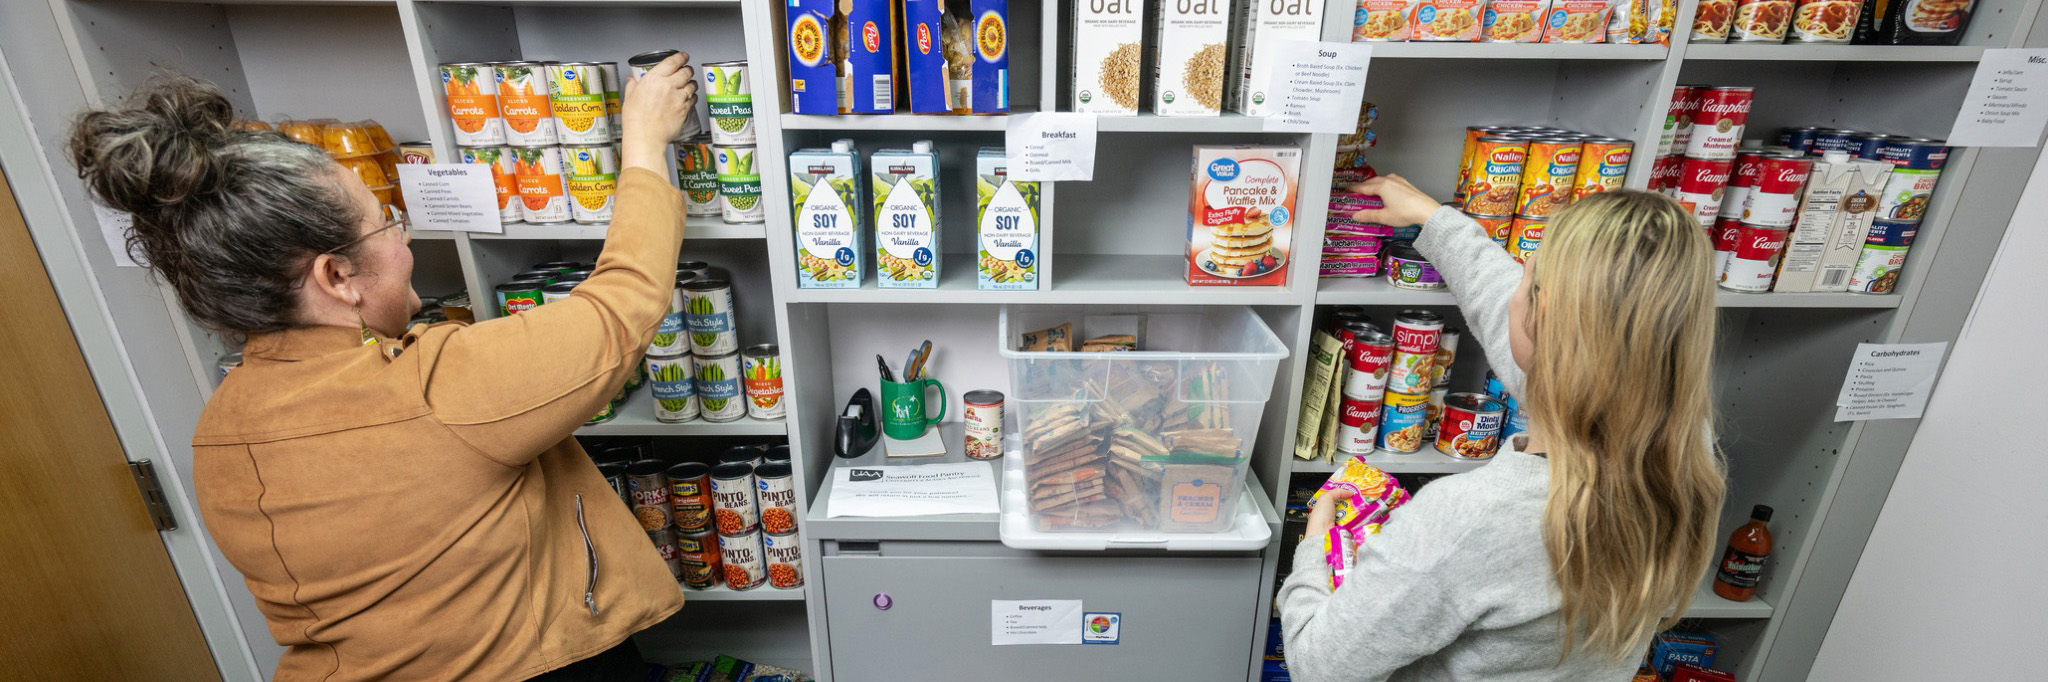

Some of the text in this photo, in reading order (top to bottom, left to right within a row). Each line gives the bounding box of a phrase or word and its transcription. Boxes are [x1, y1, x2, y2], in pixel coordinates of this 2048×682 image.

[865, 24, 879, 50] Post
[918, 27, 931, 51] Post
[1318, 49, 1337, 59] Soup
[2027, 56, 2047, 64] Misc.
[452, 105, 484, 115] Carrots
[504, 106, 538, 116] Carrots
[554, 103, 602, 112] Golden Corn
[710, 104, 751, 115] Sweet Peas
[1042, 131, 1076, 139] Breakfast
[1495, 152, 1523, 162] Nalley
[1211, 163, 1234, 172] Great
[427, 168, 468, 178] Vegetables
[680, 171, 718, 180] Sweet Peas
[683, 180, 717, 188] & Carrots
[1245, 175, 1279, 188] Complete
[518, 184, 548, 194] Carrots
[569, 182, 615, 192] Golden Corn
[722, 184, 743, 193] Sweet
[1223, 186, 1277, 196] Pancake &
[1226, 196, 1276, 205] Waffle Mix
[1224, 208, 1240, 216] Fluffy
[813, 214, 837, 228] SOY
[892, 214, 916, 228] SOY
[996, 216, 1020, 230] SOY
[1208, 215, 1233, 225] Original
[812, 238, 842, 246] Vanilla
[891, 238, 920, 246] Vanilla
[994, 239, 1022, 248] Vanilla
[840, 250, 850, 261] 7g
[917, 250, 928, 261] 7g
[1020, 252, 1030, 263] 7g
[1402, 268, 1421, 278] Yes!
[507, 303, 535, 311] Del Monte
[664, 317, 682, 328] Style
[704, 318, 724, 328] Style
[1397, 330, 1440, 349] simply
[1871, 350, 1920, 358] Carbohydrates
[651, 383, 693, 394] French Style
[714, 384, 734, 394] Style
[747, 386, 784, 397] Vegetables
[852, 470, 882, 478] UAA
[632, 488, 668, 500] PORK &
[713, 491, 744, 501] PINTO
[761, 491, 793, 502] PINTO
[724, 499, 748, 508] BEANS
[720, 547, 750, 558] PINTO
[768, 547, 797, 557] PINTO
[731, 555, 754, 564] BEANS
[780, 554, 801, 563] BEANS
[1668, 653, 1699, 663] PASTA
